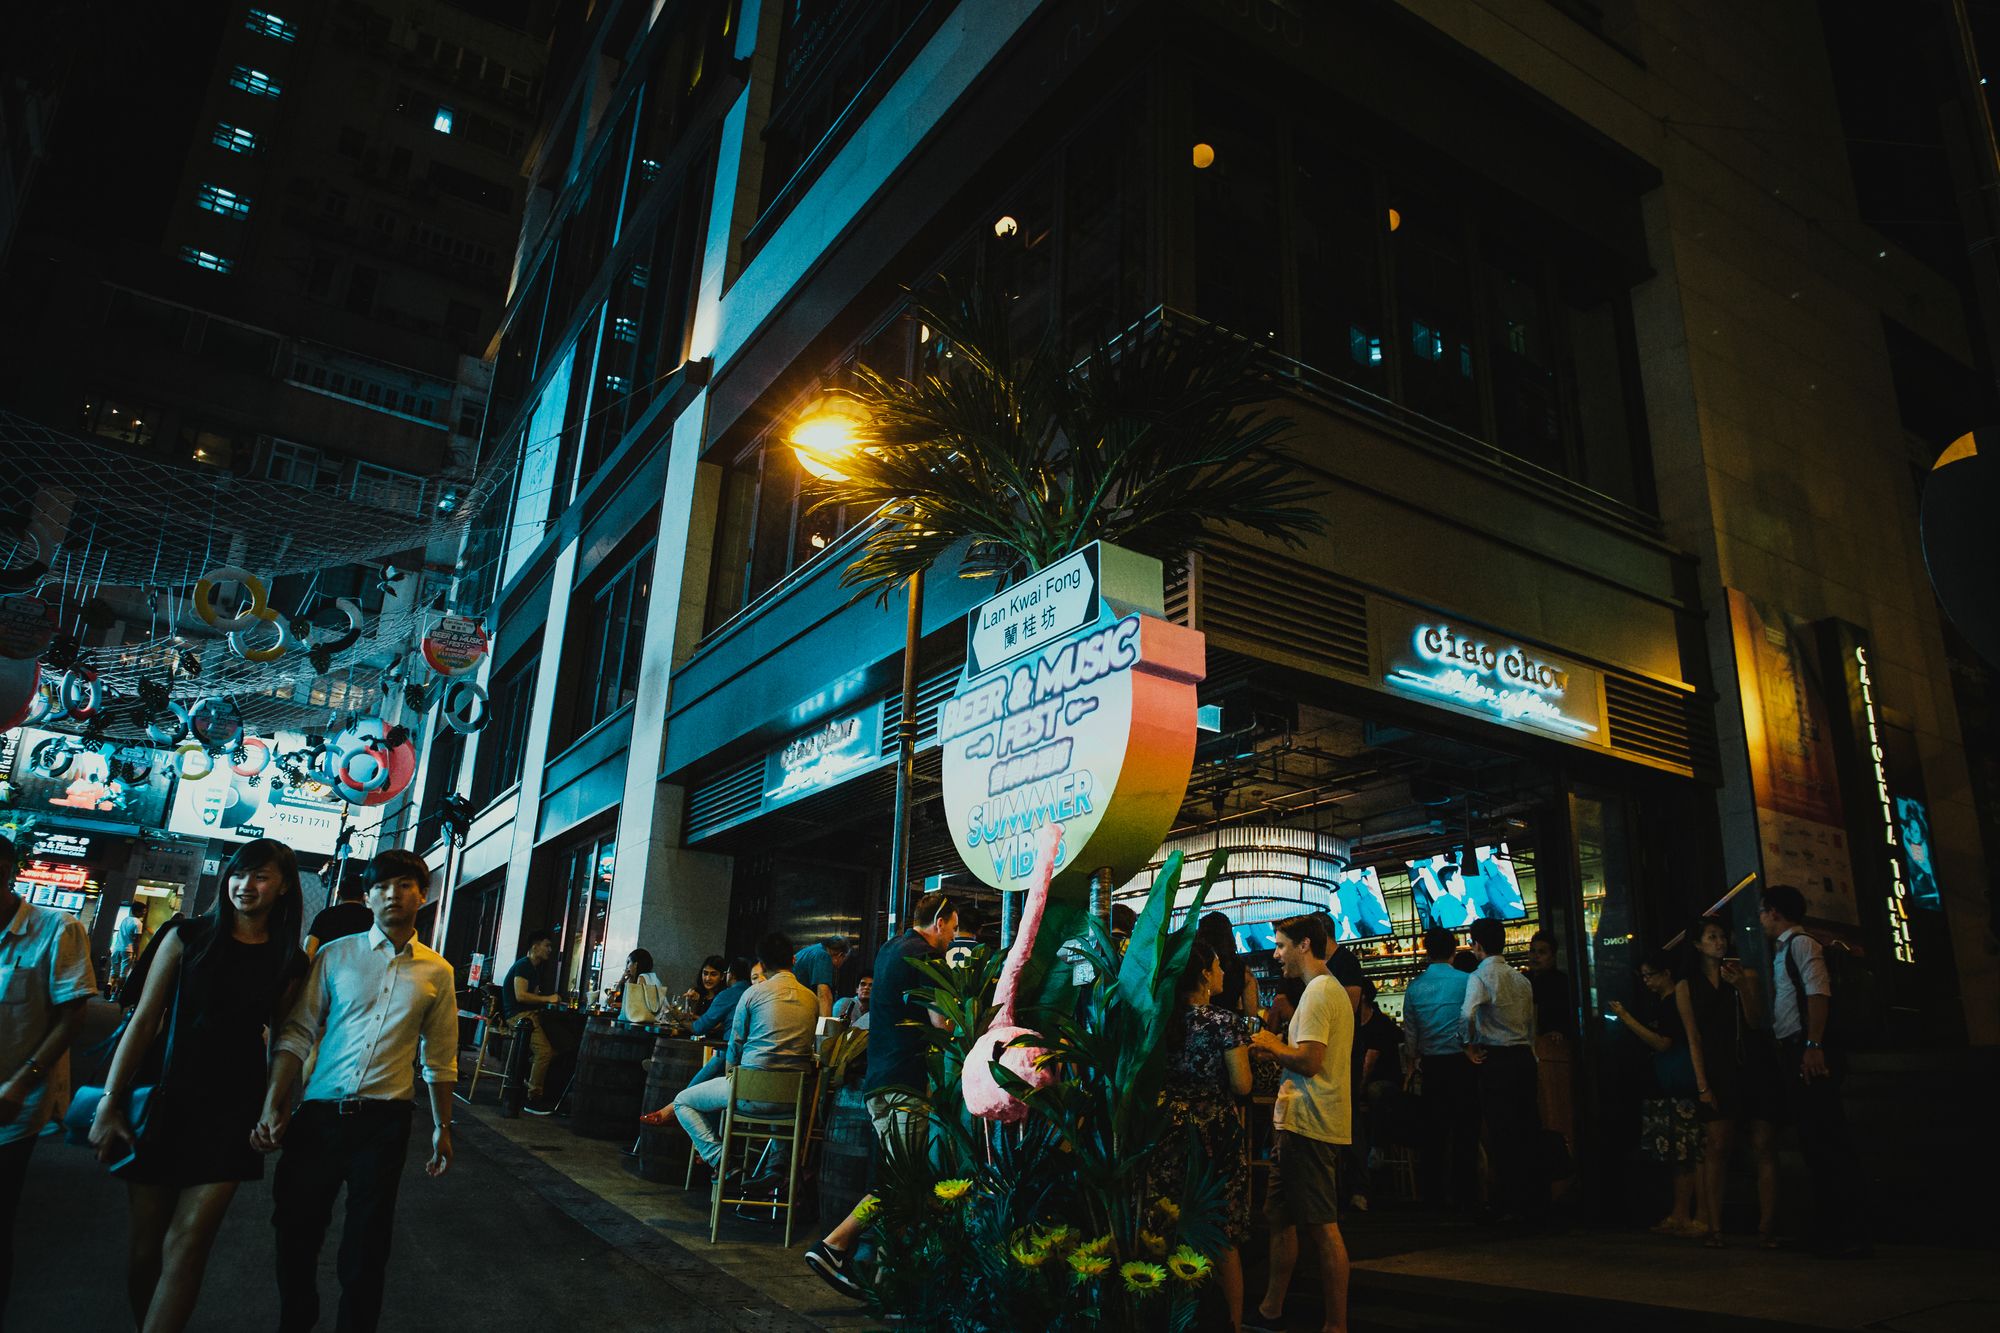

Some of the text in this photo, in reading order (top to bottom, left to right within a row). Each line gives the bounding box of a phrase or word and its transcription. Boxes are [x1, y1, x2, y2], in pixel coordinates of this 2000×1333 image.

[983, 568, 1081, 630] Lan Kwai Fong
[1004, 605, 1057, 650] 蘭桂坊
[940, 616, 1139, 744] BEER & MUSIC
[997, 692, 1065, 758] FEST
[238, 826, 263, 836] Party?
[279, 812, 331, 829] 9151 1711
[967, 769, 1093, 848] SUMMER
[987, 821, 1067, 882] VIBS
